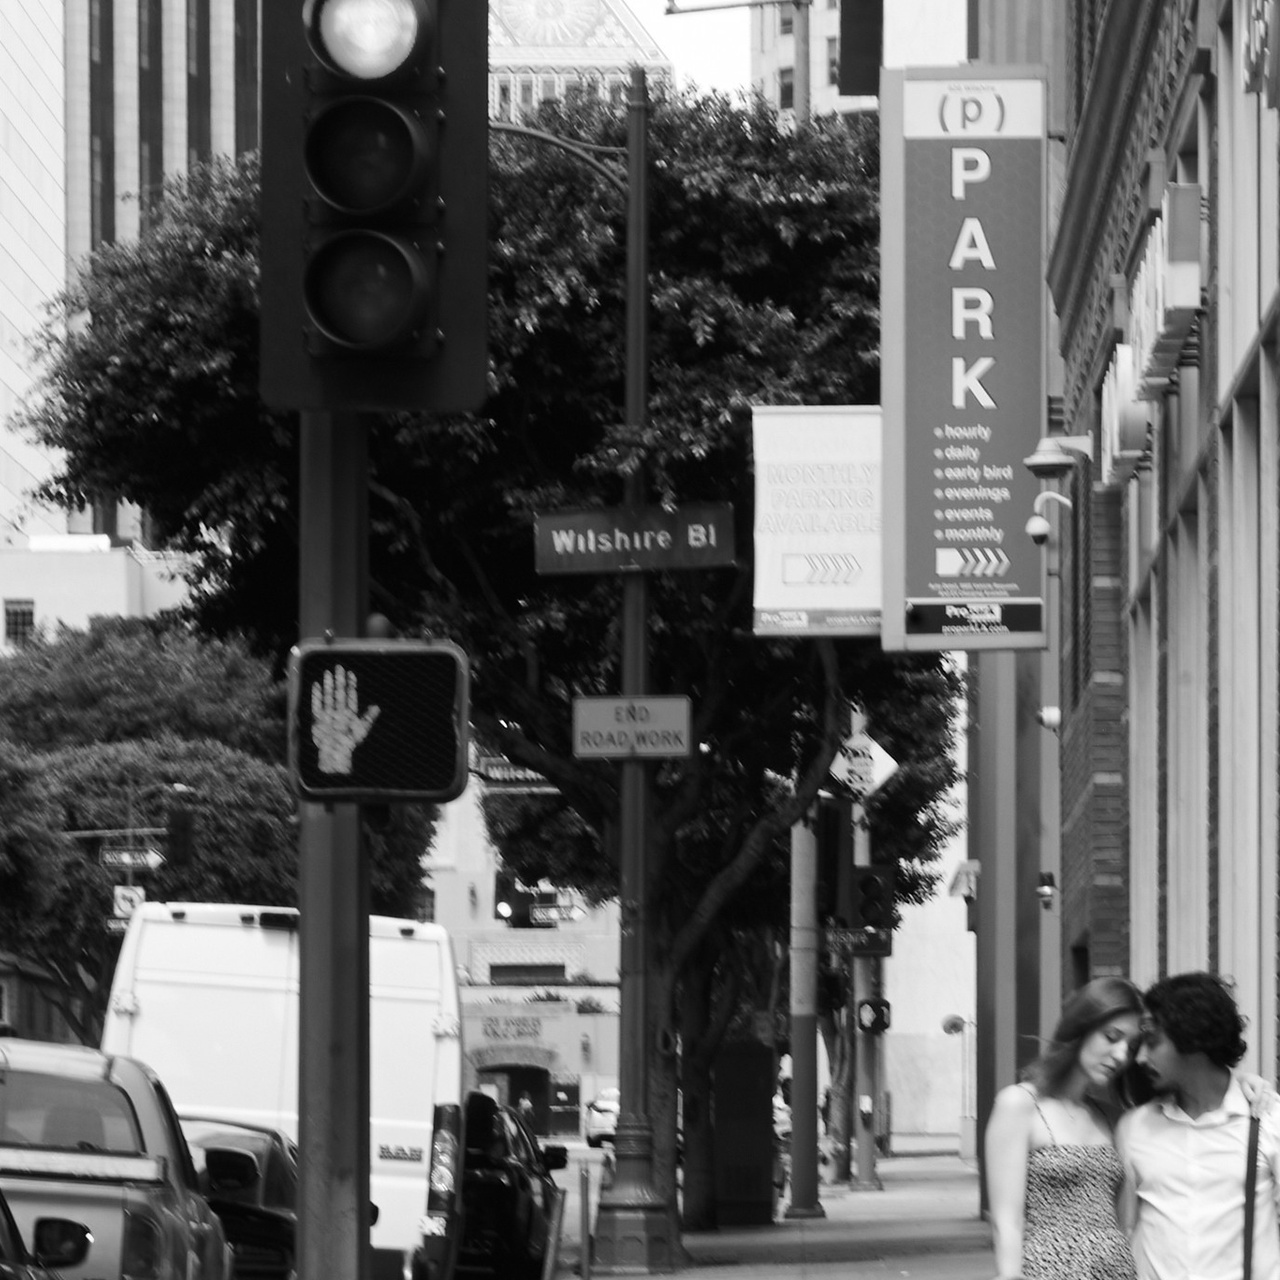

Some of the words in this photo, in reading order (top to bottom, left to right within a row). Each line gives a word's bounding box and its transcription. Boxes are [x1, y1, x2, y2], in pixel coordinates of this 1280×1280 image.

[949, 147, 997, 409] PARK
[944, 424, 992, 442] hourly
[944, 445, 980, 463] daily
[944, 465, 981, 483] early
[983, 464, 1013, 480] bird
[944, 485, 1011, 503] evenings
[944, 507, 994, 521] events
[551, 528, 672, 555] Wilshire
[687, 523, 716, 548] Bl
[944, 526, 1004, 544] monthly
[614, 704, 650, 722] END
[580, 730, 628, 747] ROAD
[634, 730, 684, 748] WORK
